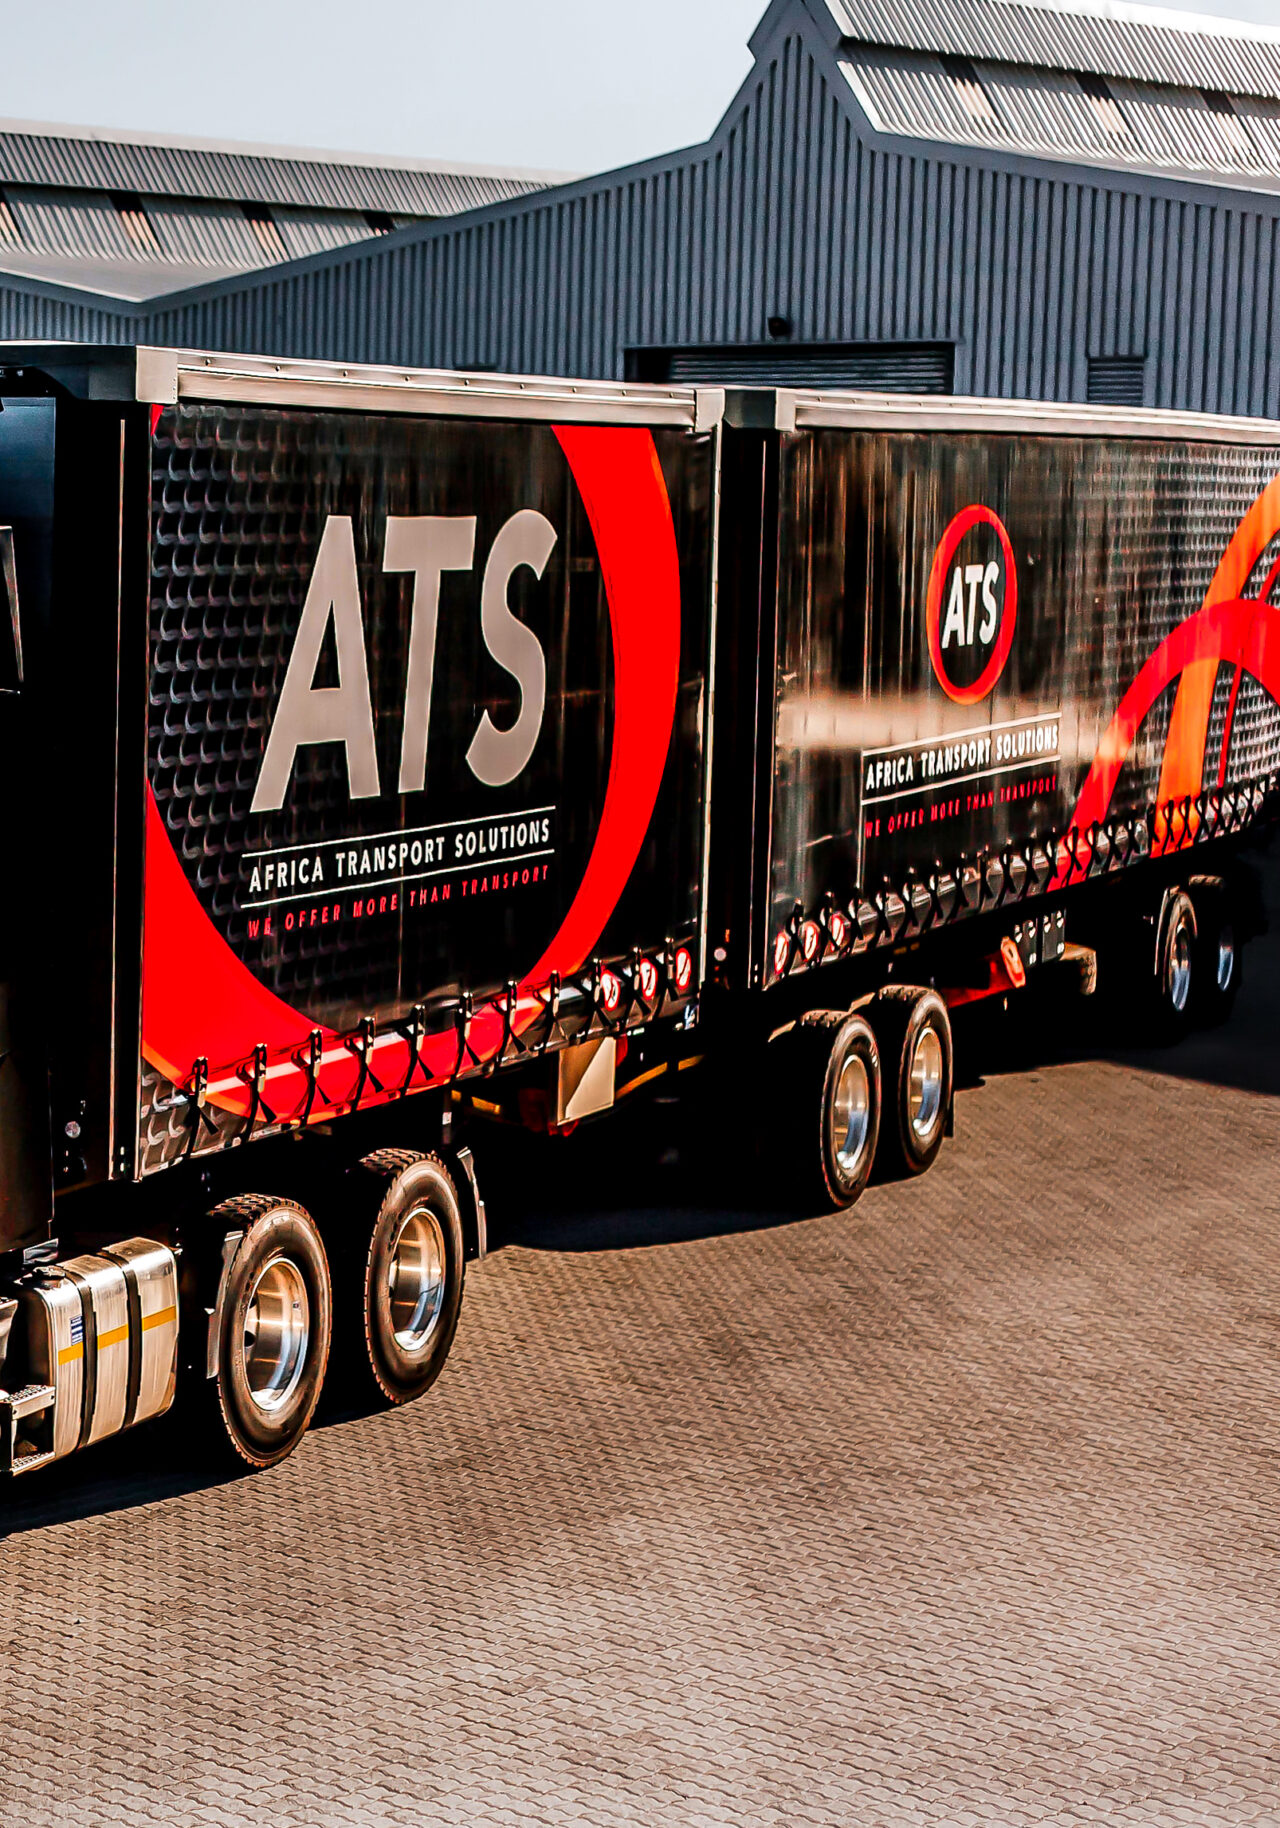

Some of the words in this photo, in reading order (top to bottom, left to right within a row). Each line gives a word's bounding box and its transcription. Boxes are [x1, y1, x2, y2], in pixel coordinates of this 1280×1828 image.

[941, 560, 1000, 649] ATS
[248, 508, 559, 814] ATS
[865, 755, 914, 791] AFRICA
[920, 738, 991, 778] TRANSPORT
[996, 725, 1058, 761] SOLUTIONS
[864, 817, 880, 839] WE
[887, 807, 924, 834] OFFER
[930, 798, 960, 822] MORE
[967, 790, 994, 812] THAN
[1000, 774, 1057, 803] TRANSPORT
[249, 856, 324, 893] AFRICA
[335, 837, 445, 878] TRANSPORT
[454, 818, 550, 858] SOLUTIONS
[247, 917, 272, 938] WE
[284, 904, 341, 931] OFFER
[352, 893, 398, 919] MORE
[409, 884, 451, 907] THAN
[461, 865, 549, 897] TRANSPORT
